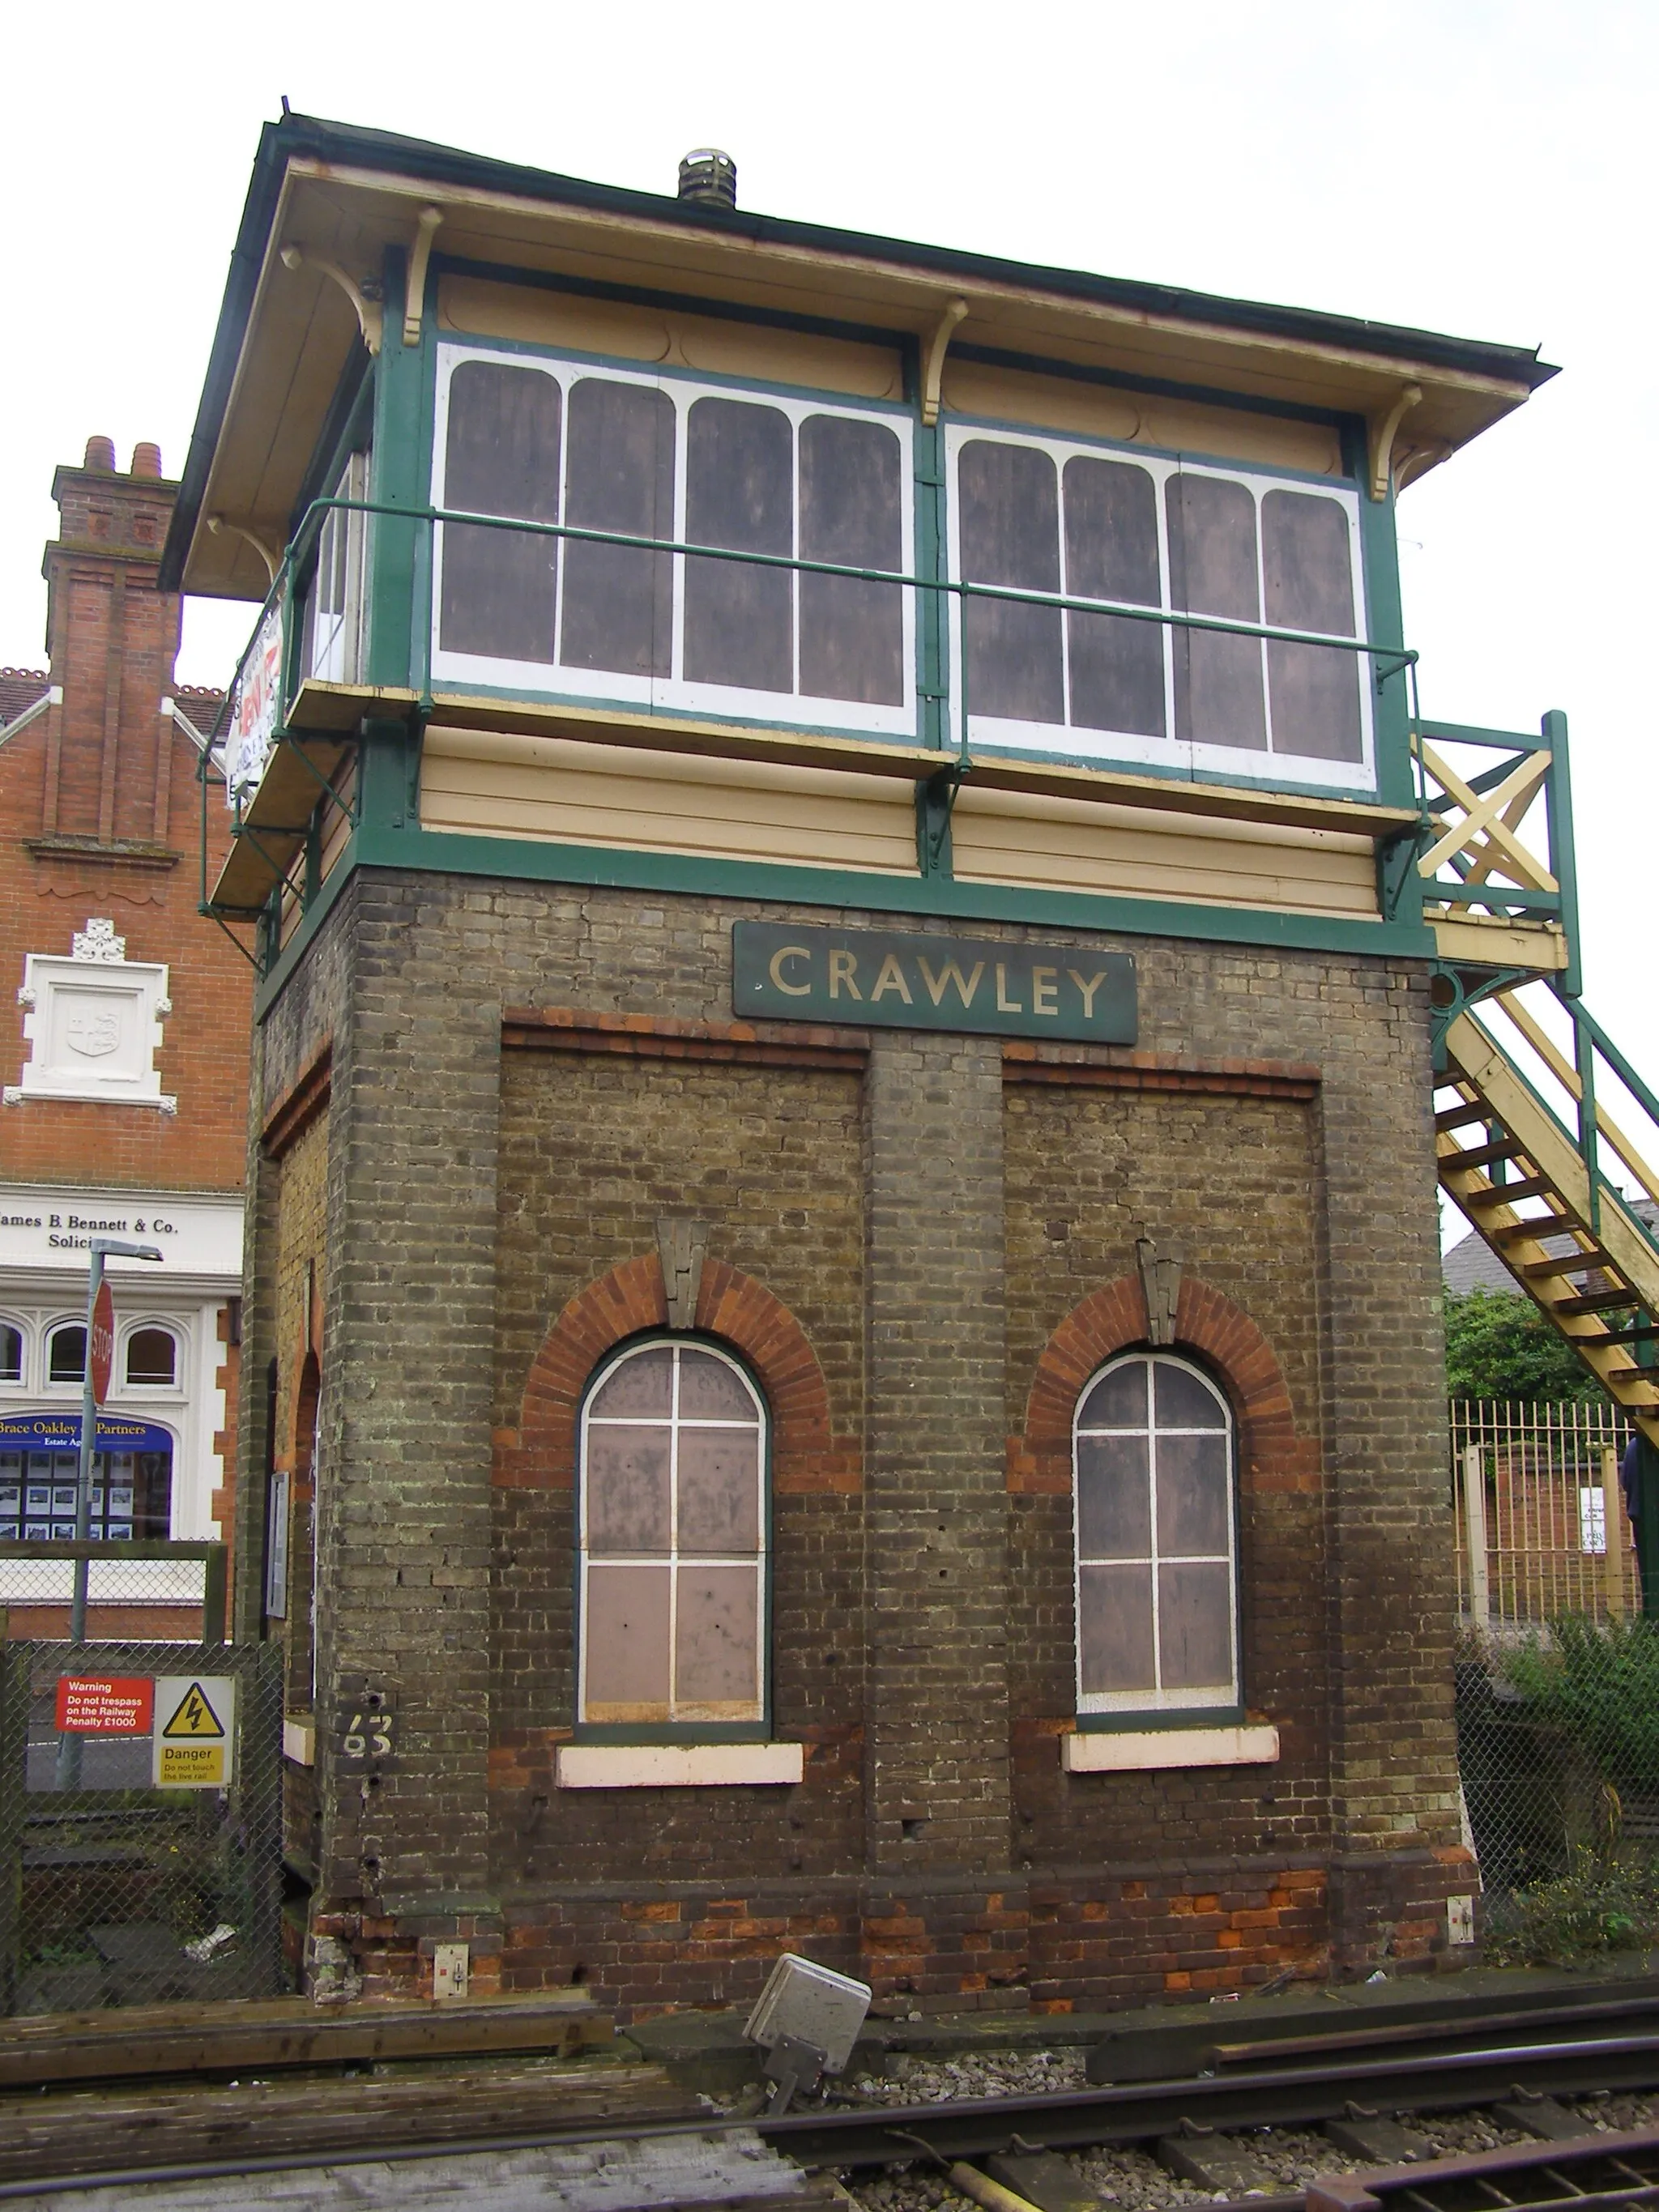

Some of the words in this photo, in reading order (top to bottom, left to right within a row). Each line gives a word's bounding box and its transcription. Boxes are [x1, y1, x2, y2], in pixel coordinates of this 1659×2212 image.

[769, 945, 1108, 1019] CRAWLEY
[0, 1212, 41, 1227] ames
[49, 1214, 62, 1228] B.
[68, 1216, 126, 1231] Bennett
[134, 1218, 146, 1232] &
[153, 1220, 178, 1234] Co.
[49, 1234, 92, 1248] Solici
[93, 1323, 113, 1362] STOP
[33, 1421, 77, 1435] Oakley
[96, 1422, 146, 1434] Partners
[45, 1438, 68, 1446] Estate
[69, 1681, 112, 1694] Warning
[67, 1695, 81, 1705] Do
[83, 1697, 99, 1705] not
[101, 1697, 142, 1707] trespass
[82, 1707, 97, 1715] the
[99, 1707, 136, 1717] Railway
[66, 1716, 102, 1728] Penalty
[104, 1717, 136, 1727] £1000
[343, 1715, 392, 1754] 63
[165, 1749, 212, 1761] Danger
